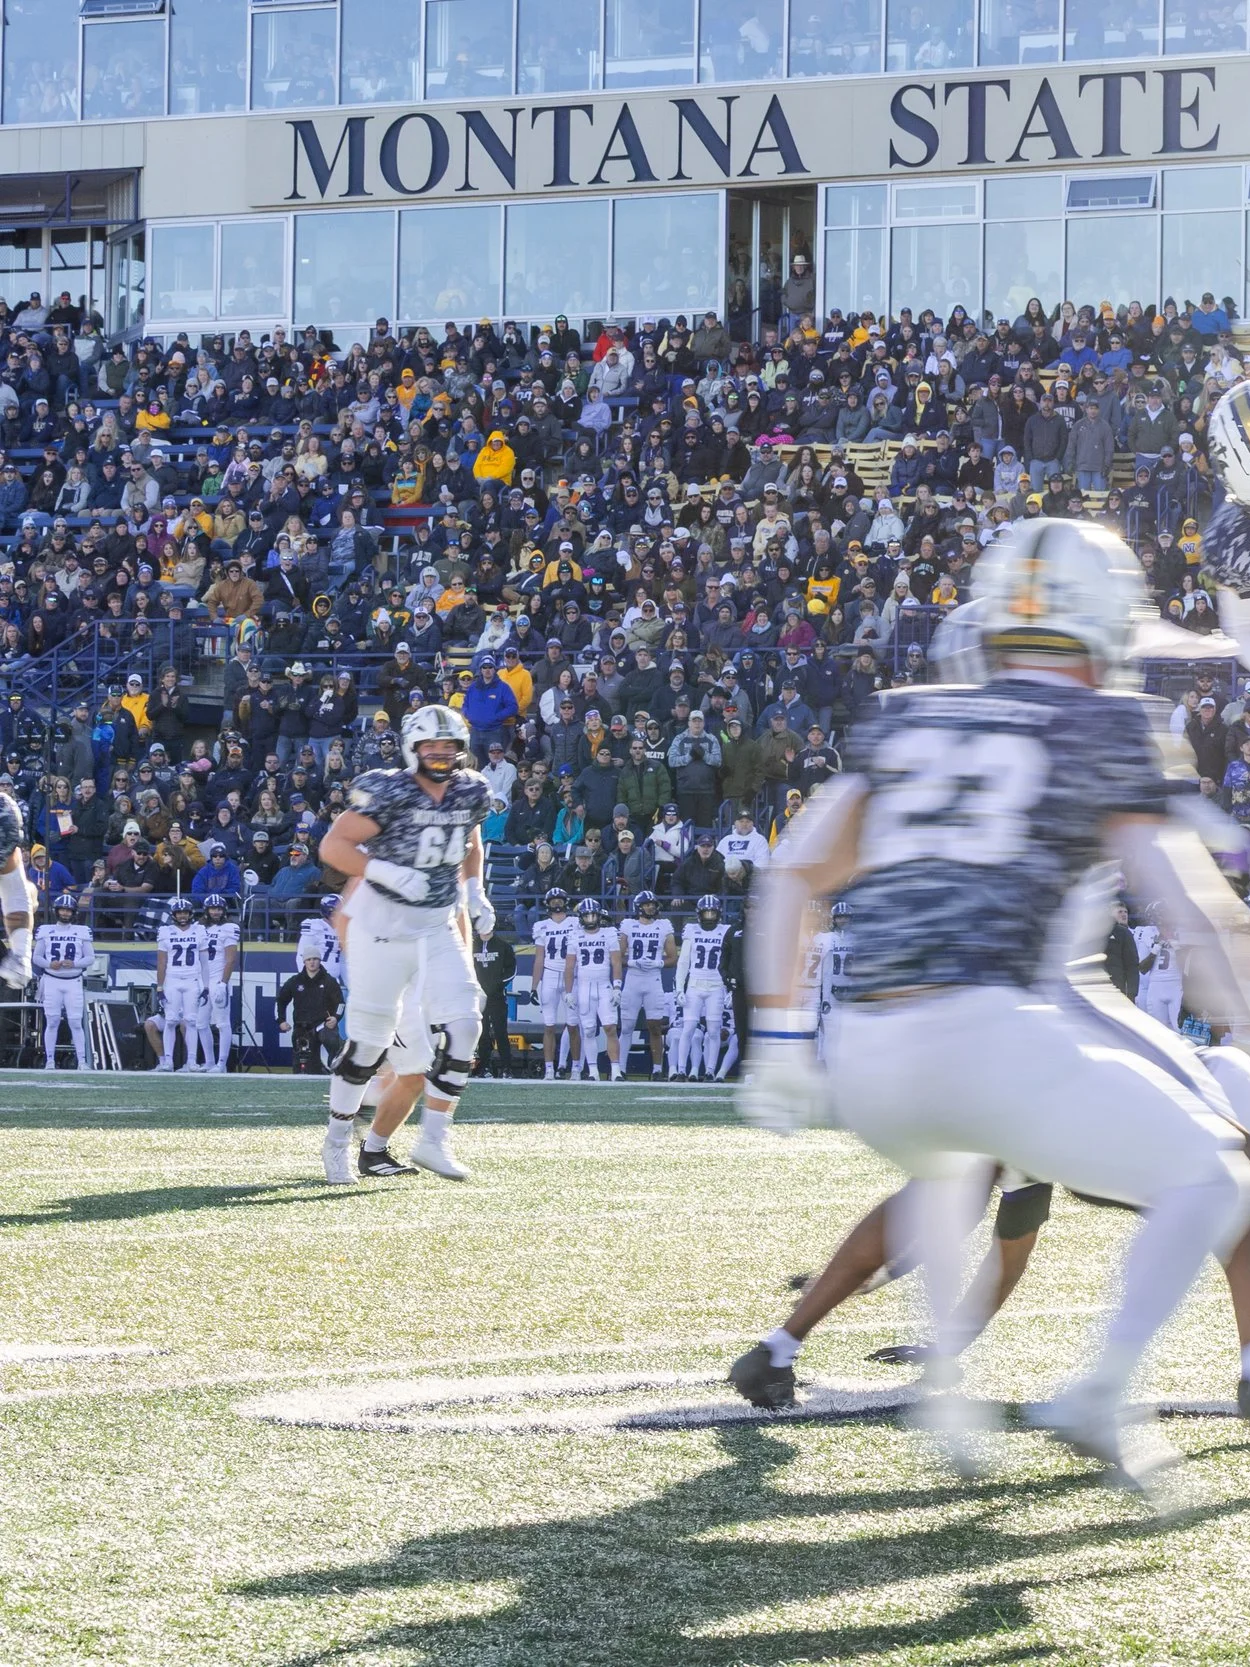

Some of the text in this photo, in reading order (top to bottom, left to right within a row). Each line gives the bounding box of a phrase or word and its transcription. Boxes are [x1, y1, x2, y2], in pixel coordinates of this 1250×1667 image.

[284, 93, 811, 201] MONTANA
[888, 66, 1222, 170] STATE
[413, 825, 465, 869] 64
[545, 929, 573, 937] WILDCAT
[631, 931, 659, 939] WILDCATS
[172, 943, 197, 967] 26
[632, 939, 659, 960] 85
[694, 945, 722, 969] 36
